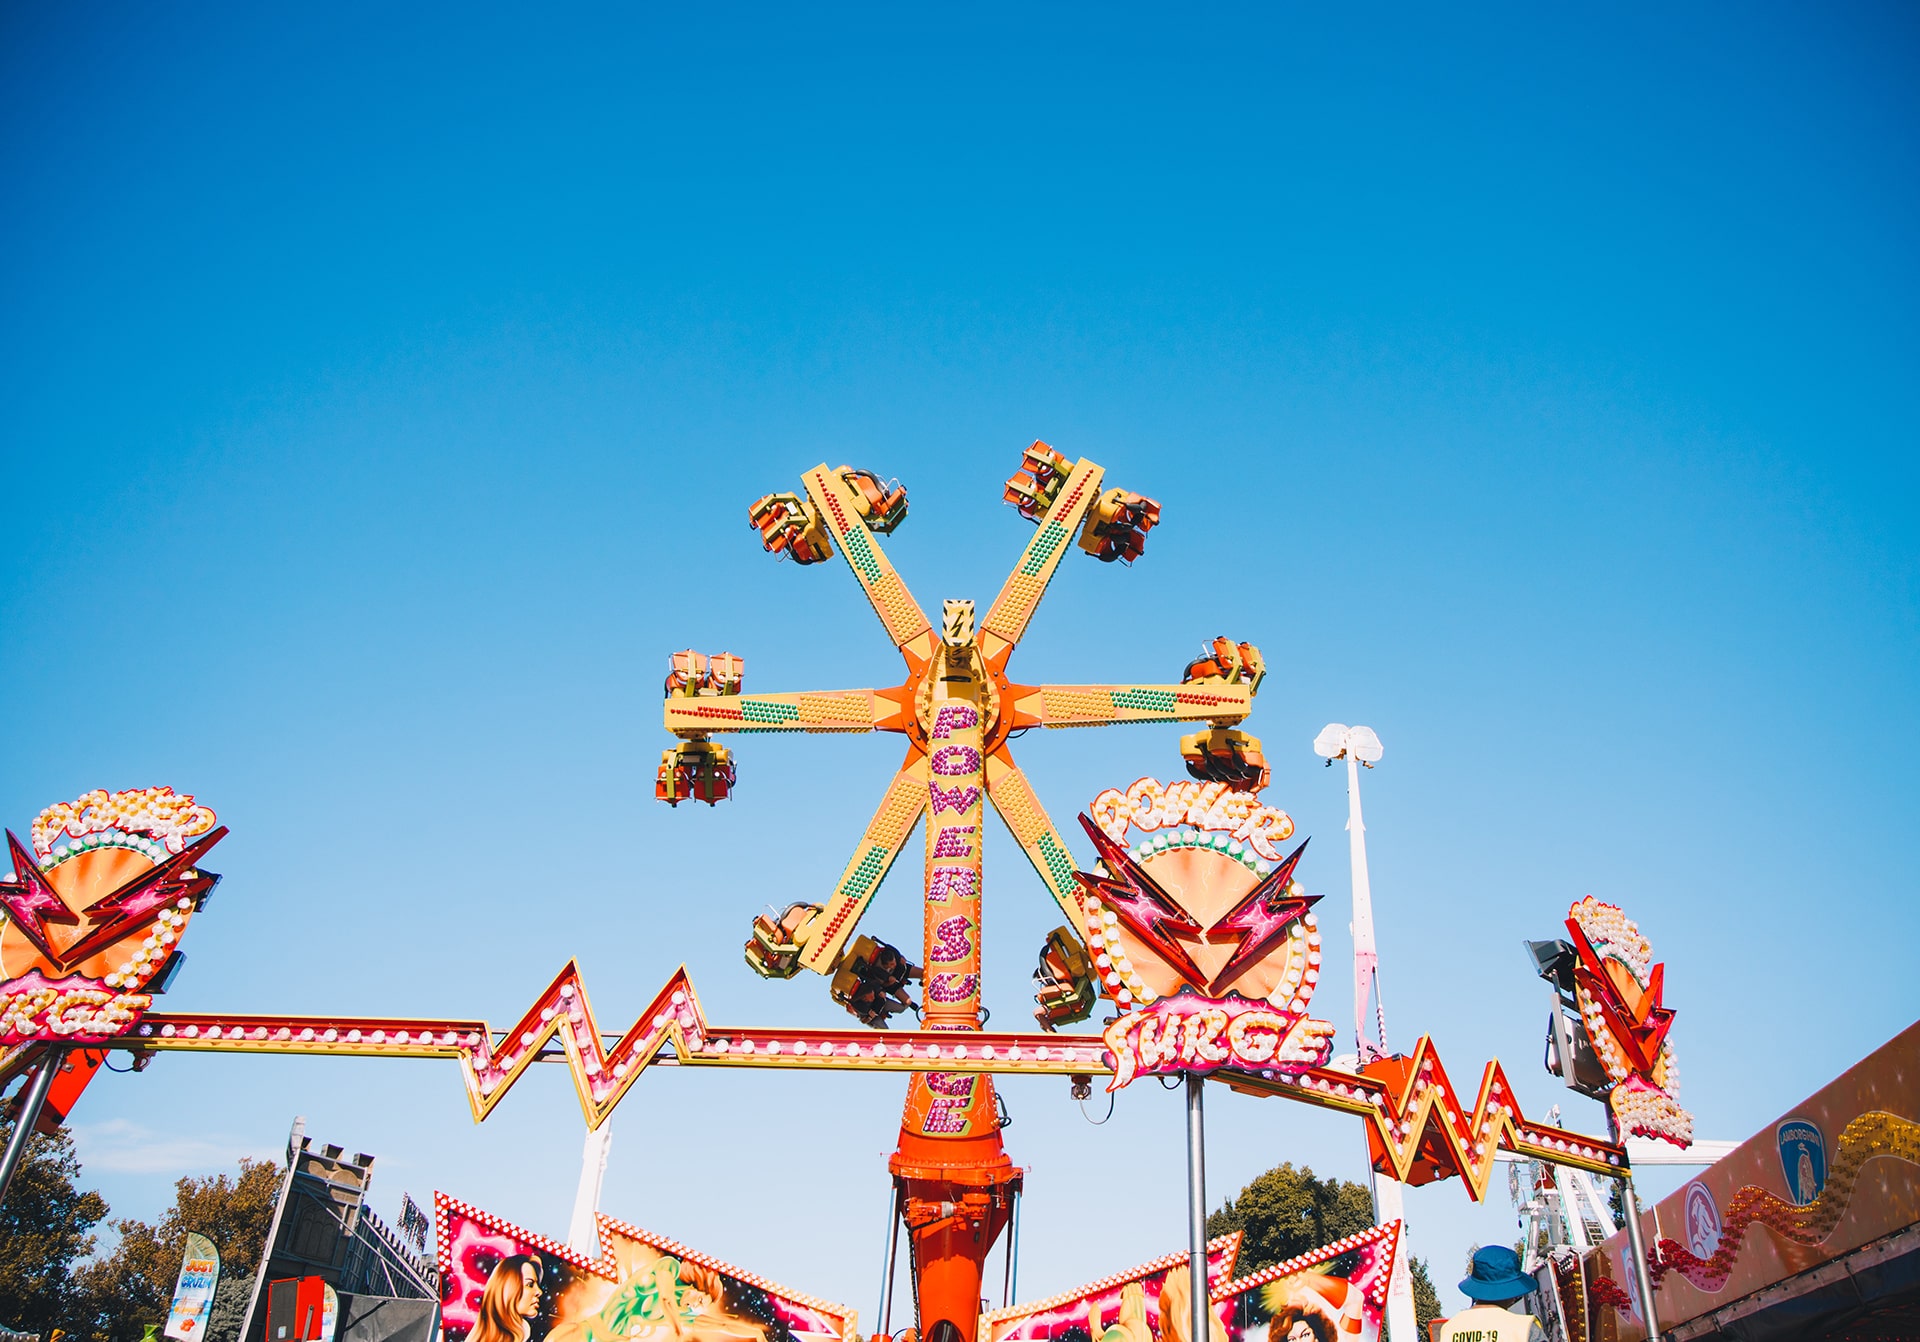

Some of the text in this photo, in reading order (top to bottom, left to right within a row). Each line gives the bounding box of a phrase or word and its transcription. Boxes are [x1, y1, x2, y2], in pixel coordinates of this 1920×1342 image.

[1089, 776, 1295, 861] POWER
[1103, 1008, 1336, 1093] SURGE
[185, 1258, 215, 1273] JUST
[1452, 1330, 1498, 1342] COVID-19
